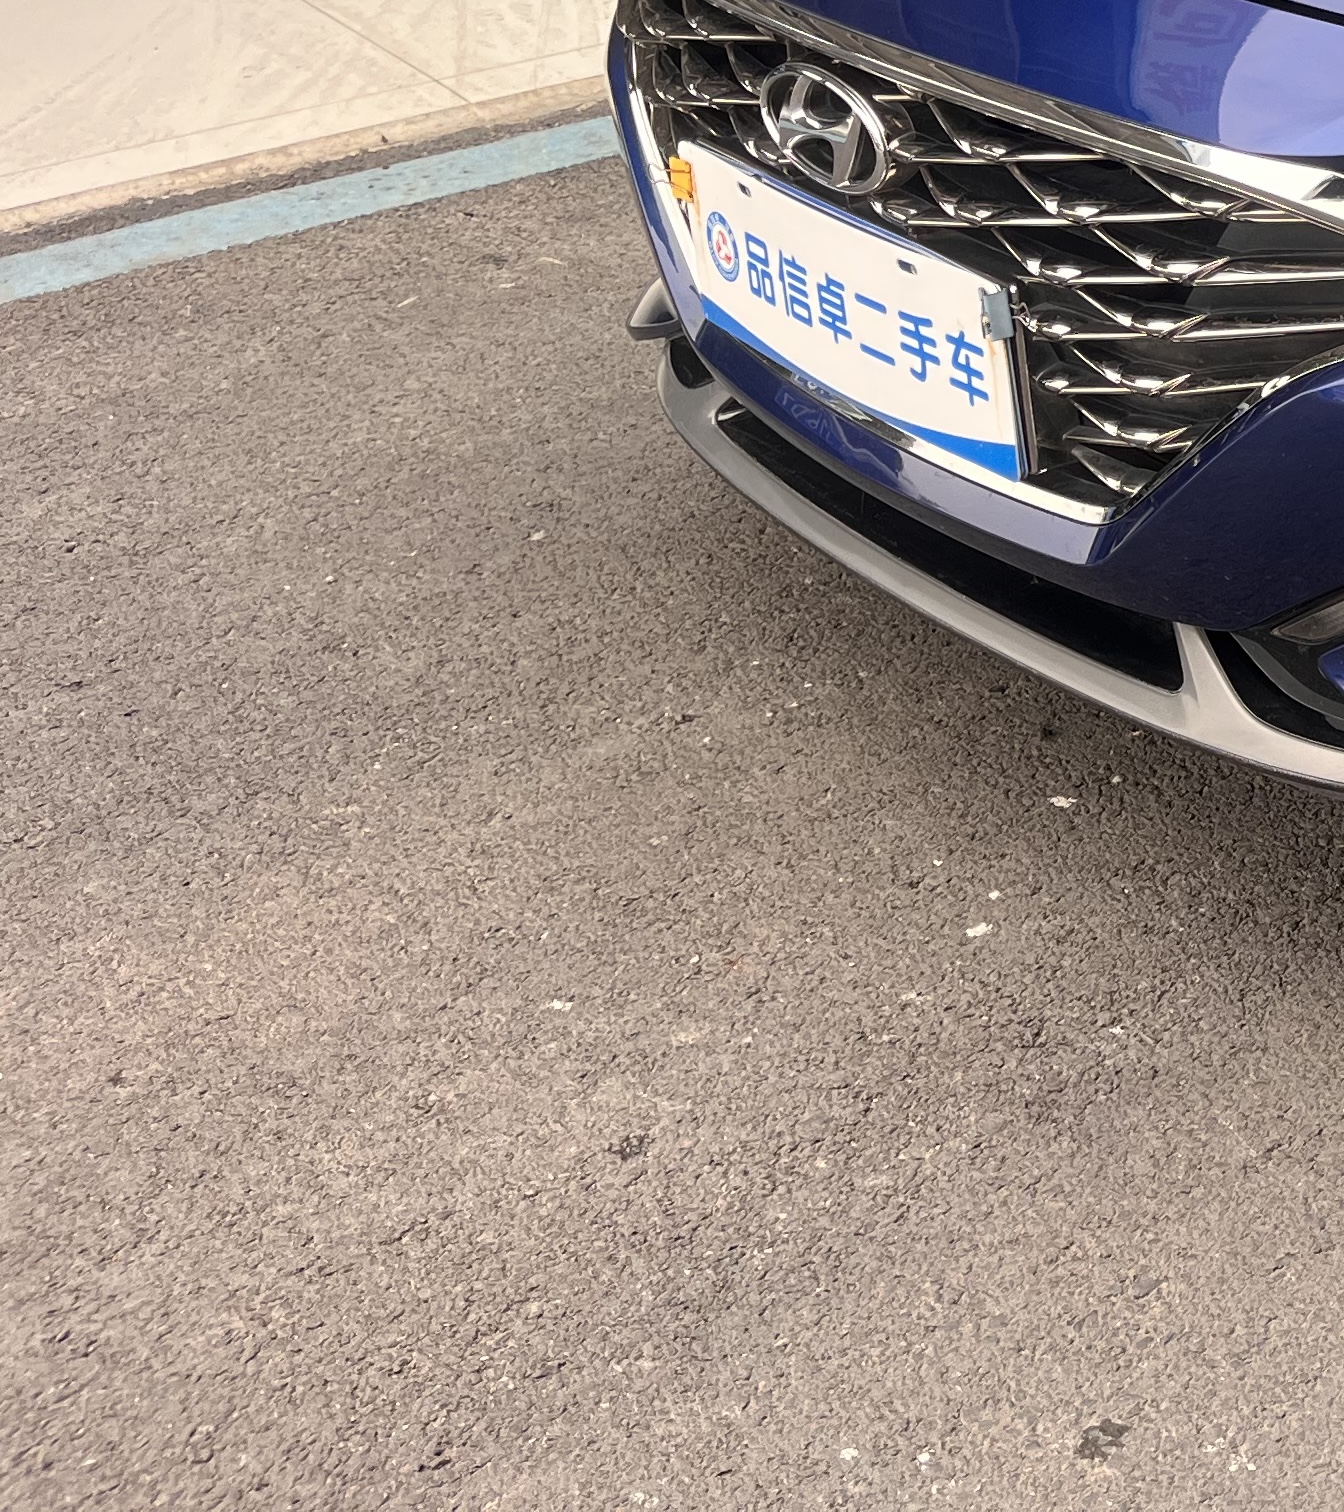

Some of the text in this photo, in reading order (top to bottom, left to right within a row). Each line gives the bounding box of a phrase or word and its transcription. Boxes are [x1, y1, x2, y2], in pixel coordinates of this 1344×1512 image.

[743, 228, 993, 409] 品信卓二手车
